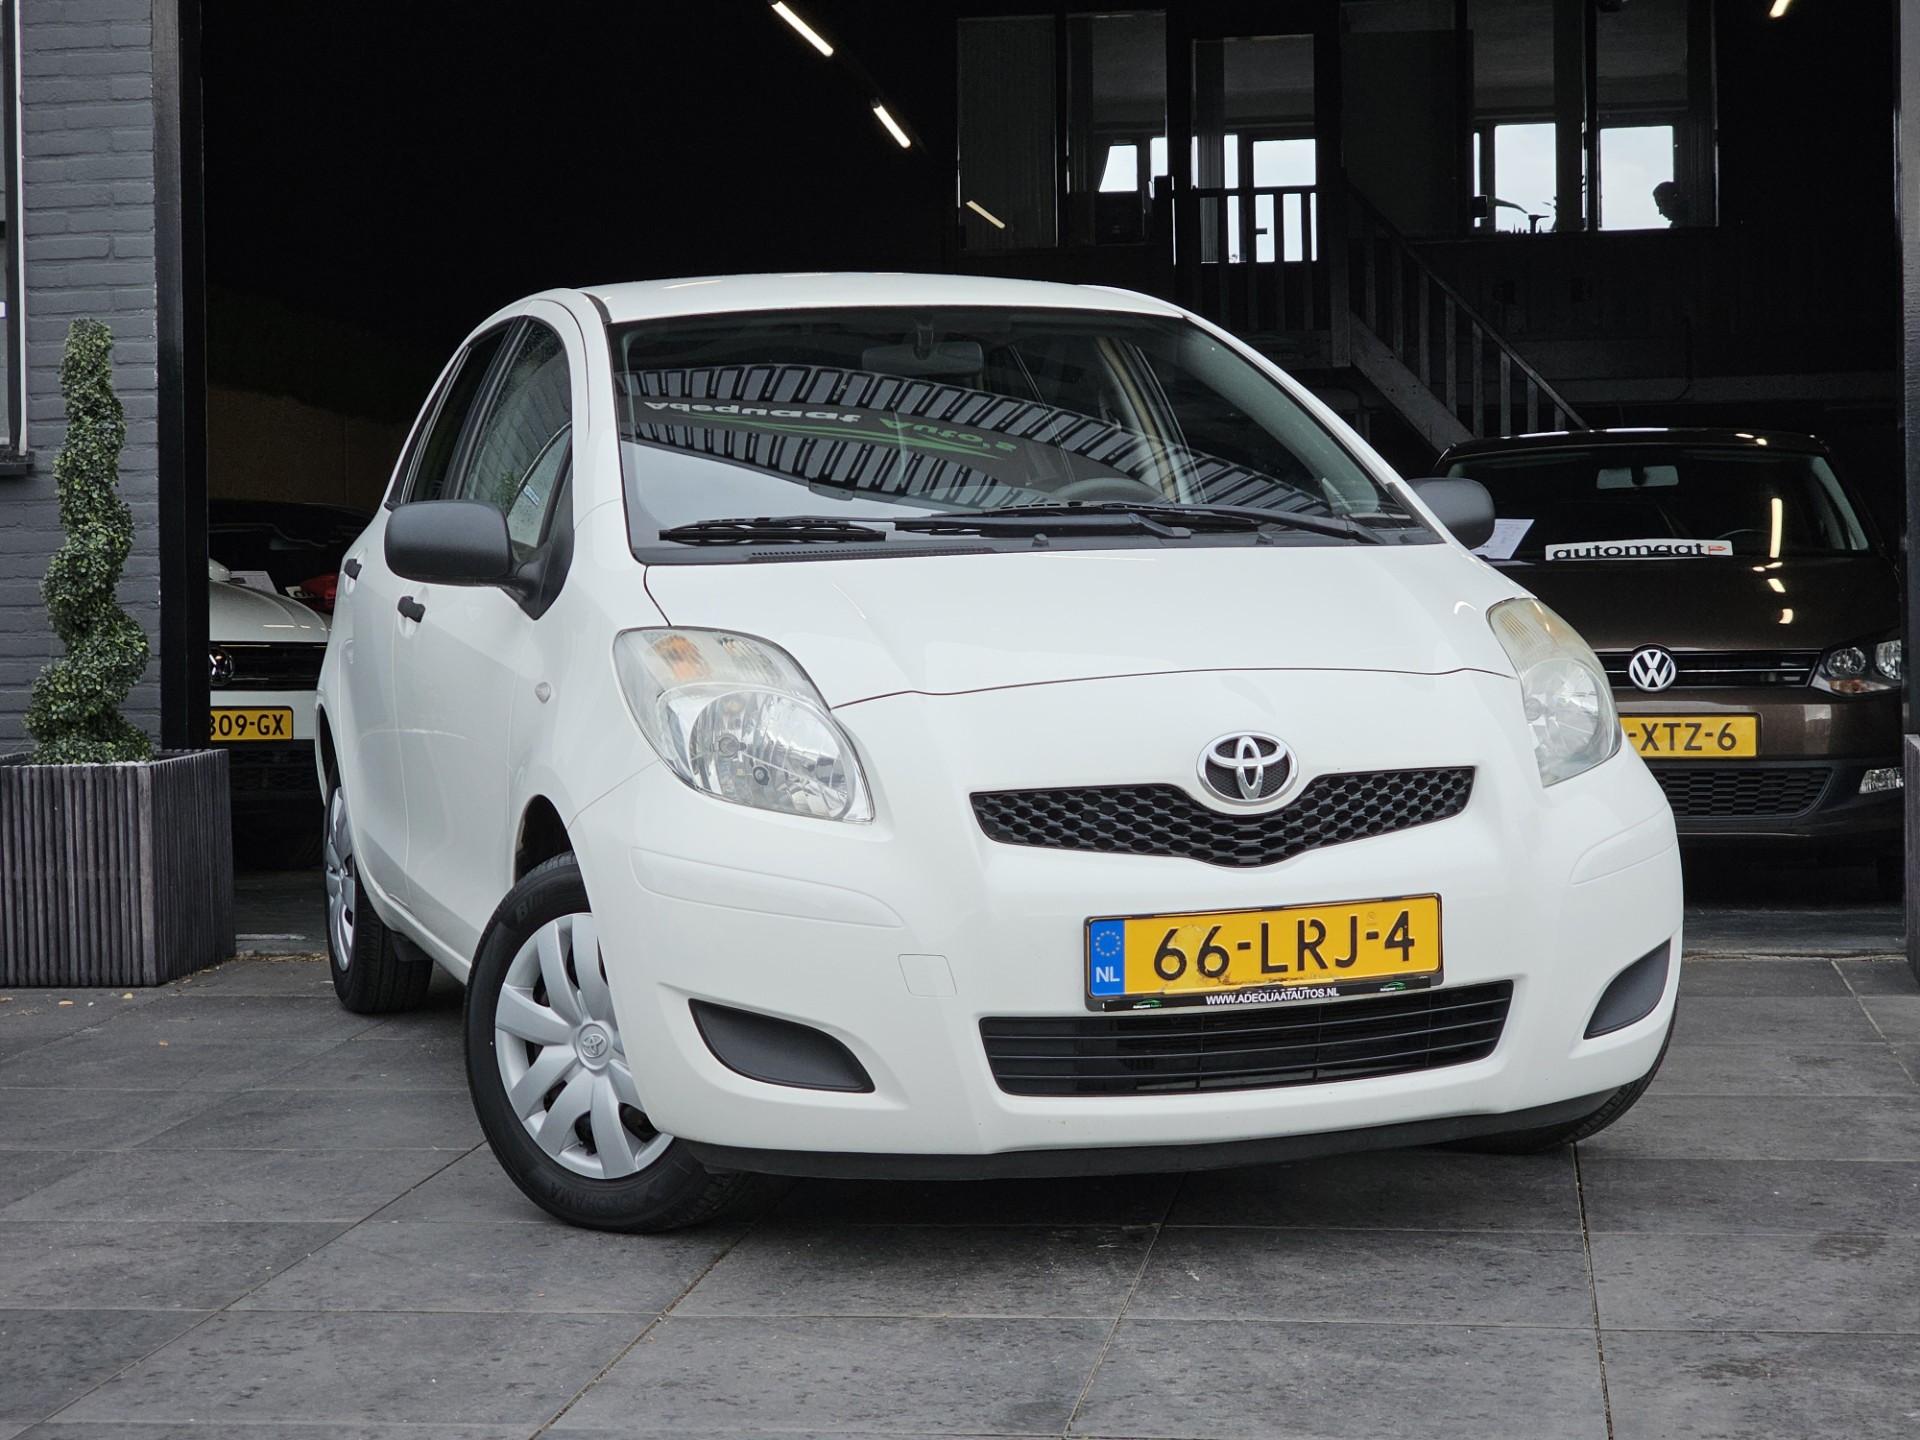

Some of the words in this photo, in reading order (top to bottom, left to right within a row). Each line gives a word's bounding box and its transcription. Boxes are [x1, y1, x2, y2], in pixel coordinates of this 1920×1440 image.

[1153, 910, 1415, 981] 66-LRJ-4
[1095, 966, 1120, 984] NL
[1205, 987, 1340, 1005] WWW.ADEQUAATAUTOS.NL
